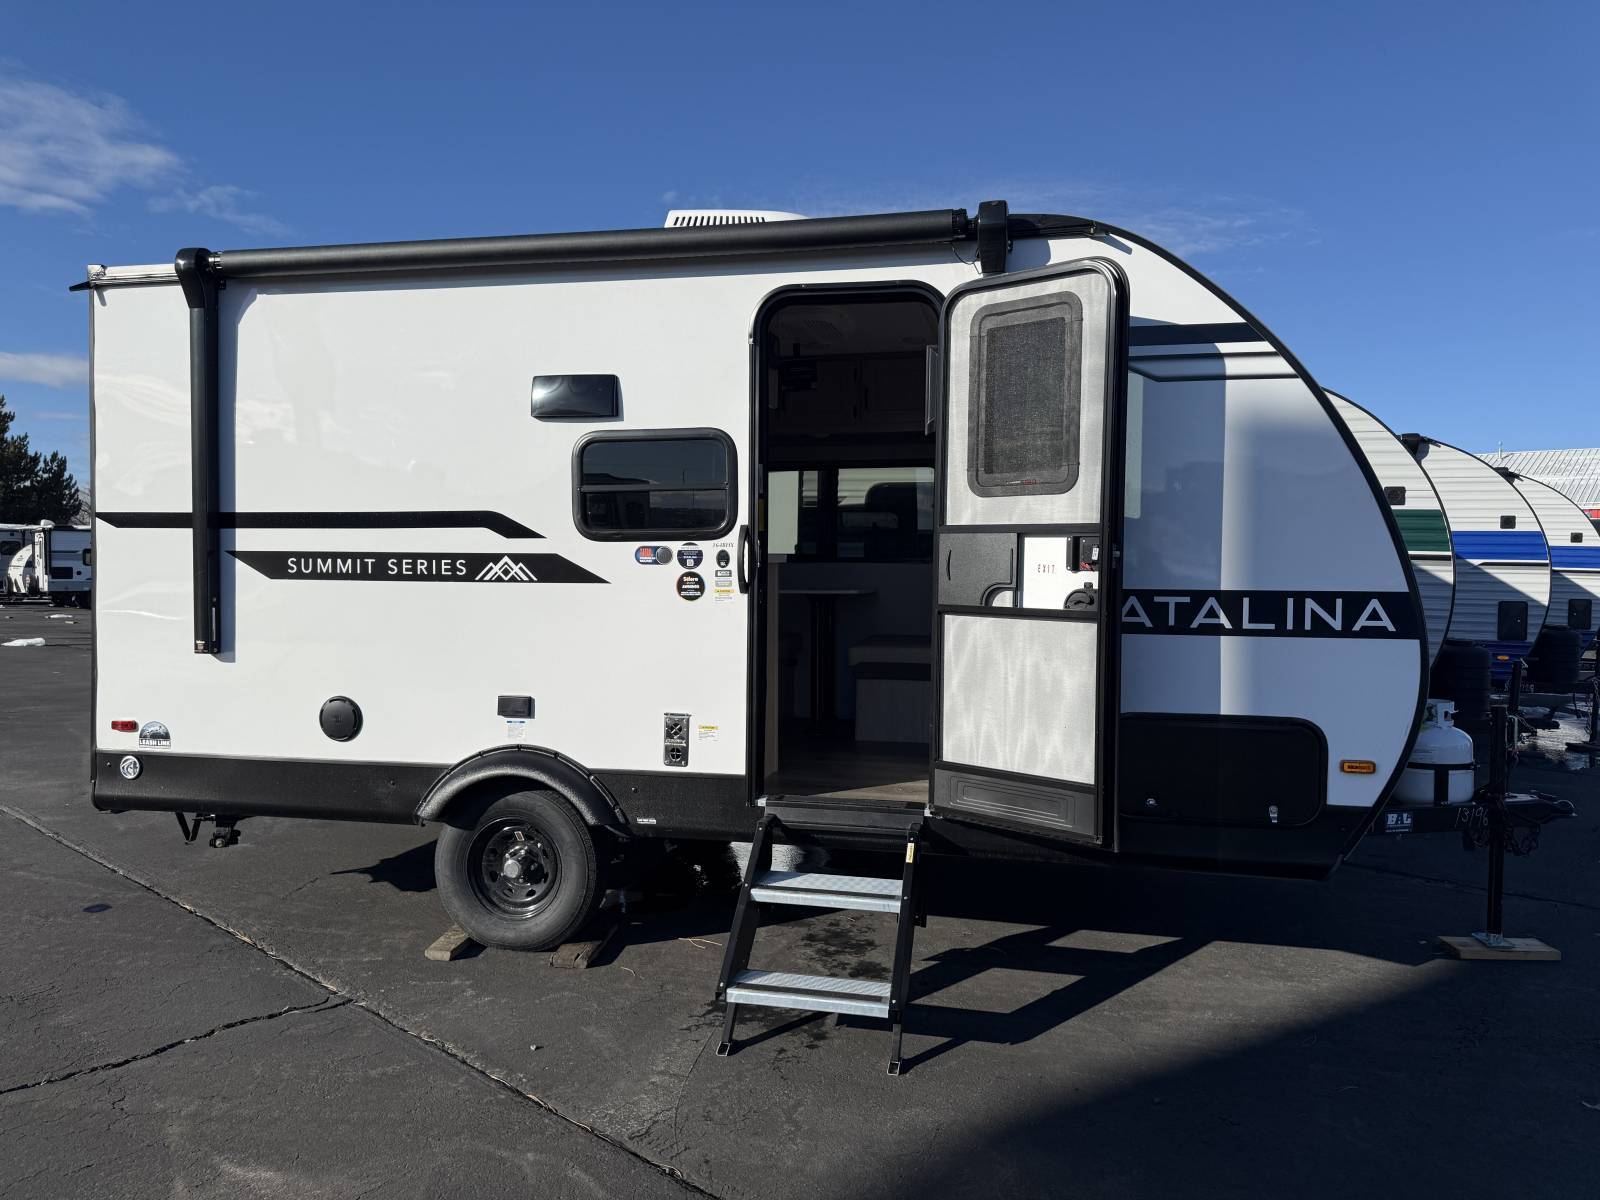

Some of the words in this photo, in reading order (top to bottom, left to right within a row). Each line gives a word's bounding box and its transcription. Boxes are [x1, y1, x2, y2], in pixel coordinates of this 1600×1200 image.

[287, 557, 376, 575] SUMMIT
[387, 559, 467, 576] SERIES
[1037, 563, 1056, 574] EXIT
